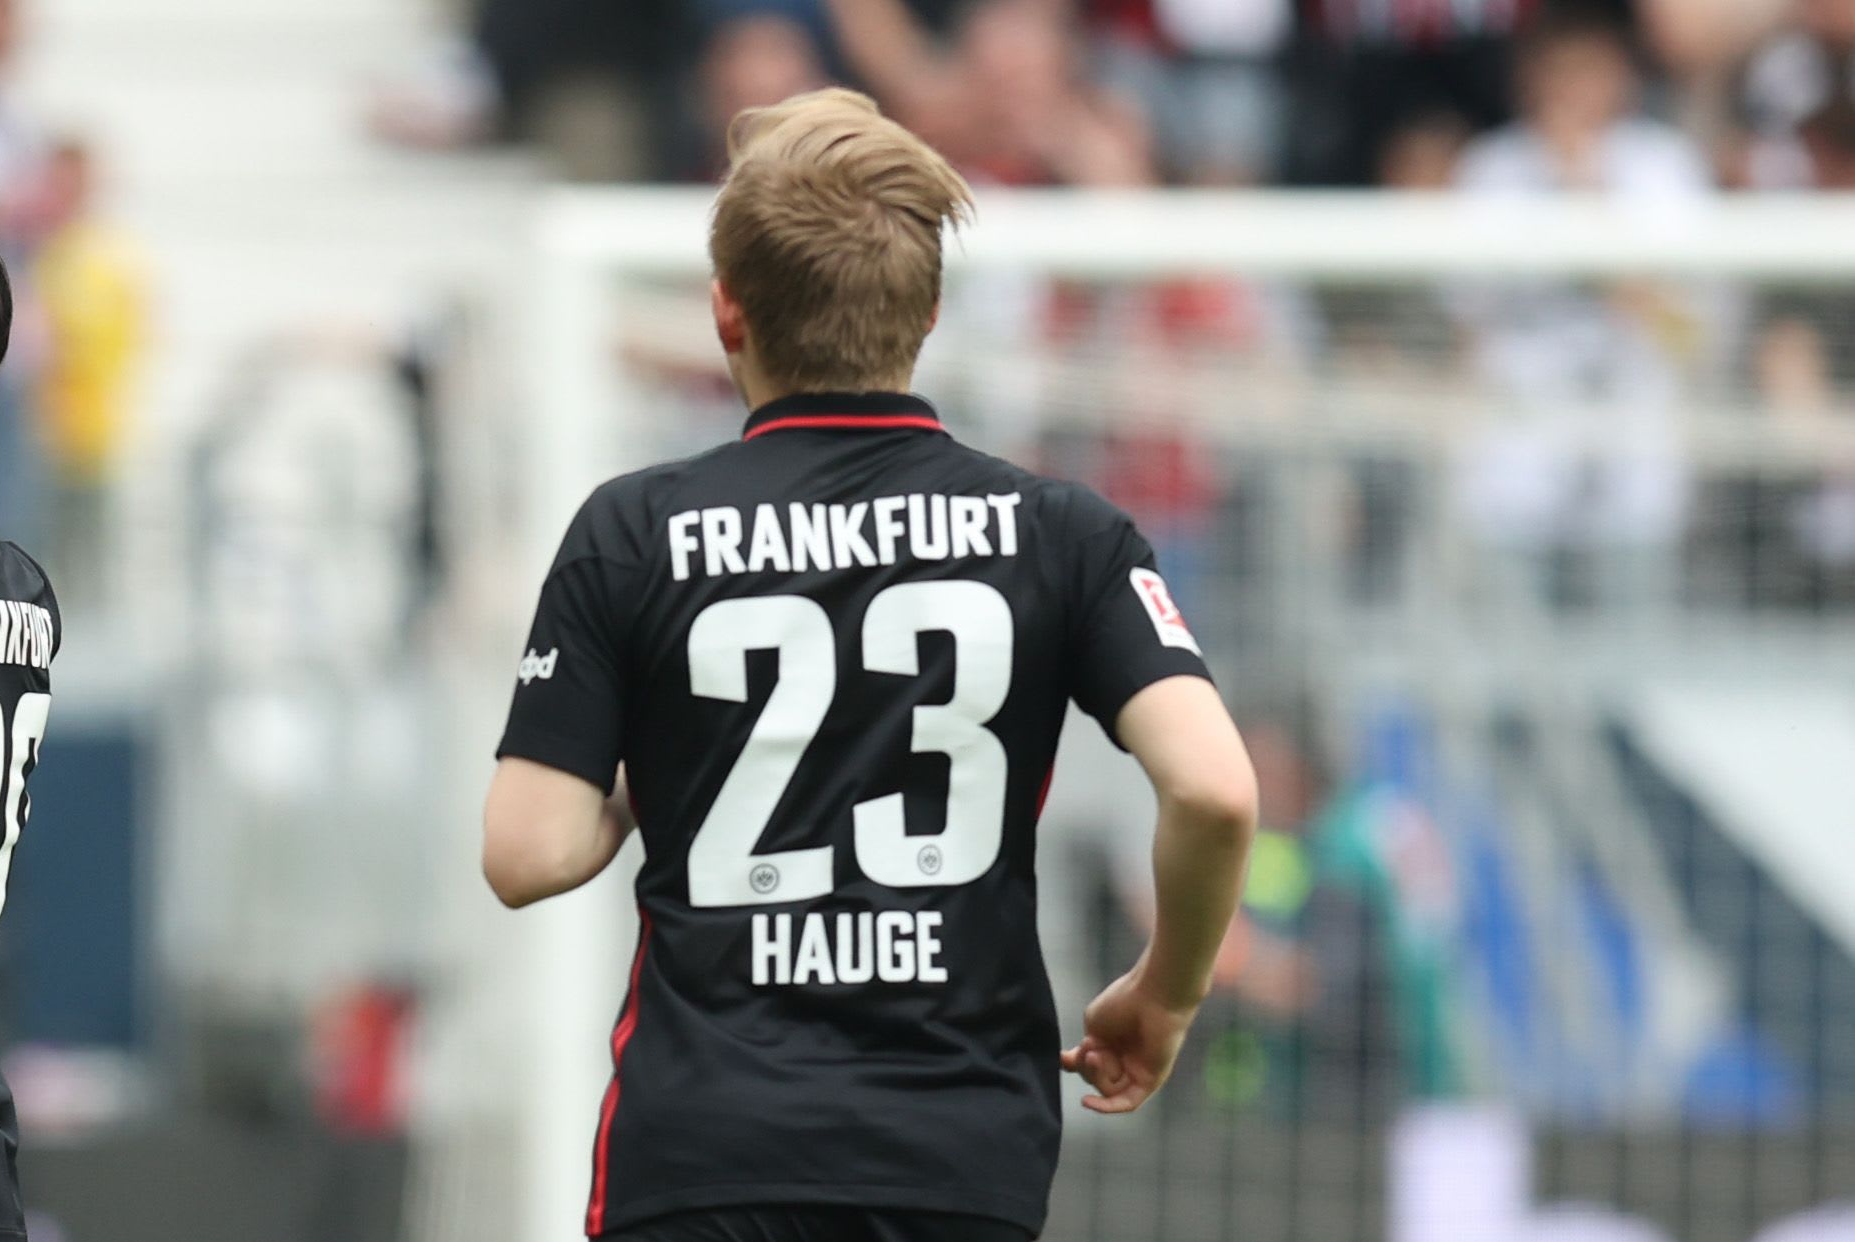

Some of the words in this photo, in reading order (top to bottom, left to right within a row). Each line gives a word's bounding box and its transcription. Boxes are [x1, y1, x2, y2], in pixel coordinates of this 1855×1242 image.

[668, 492, 1022, 581] FRANKFURT
[687, 579, 1014, 908] 23
[751, 910, 948, 986] HAUGE
